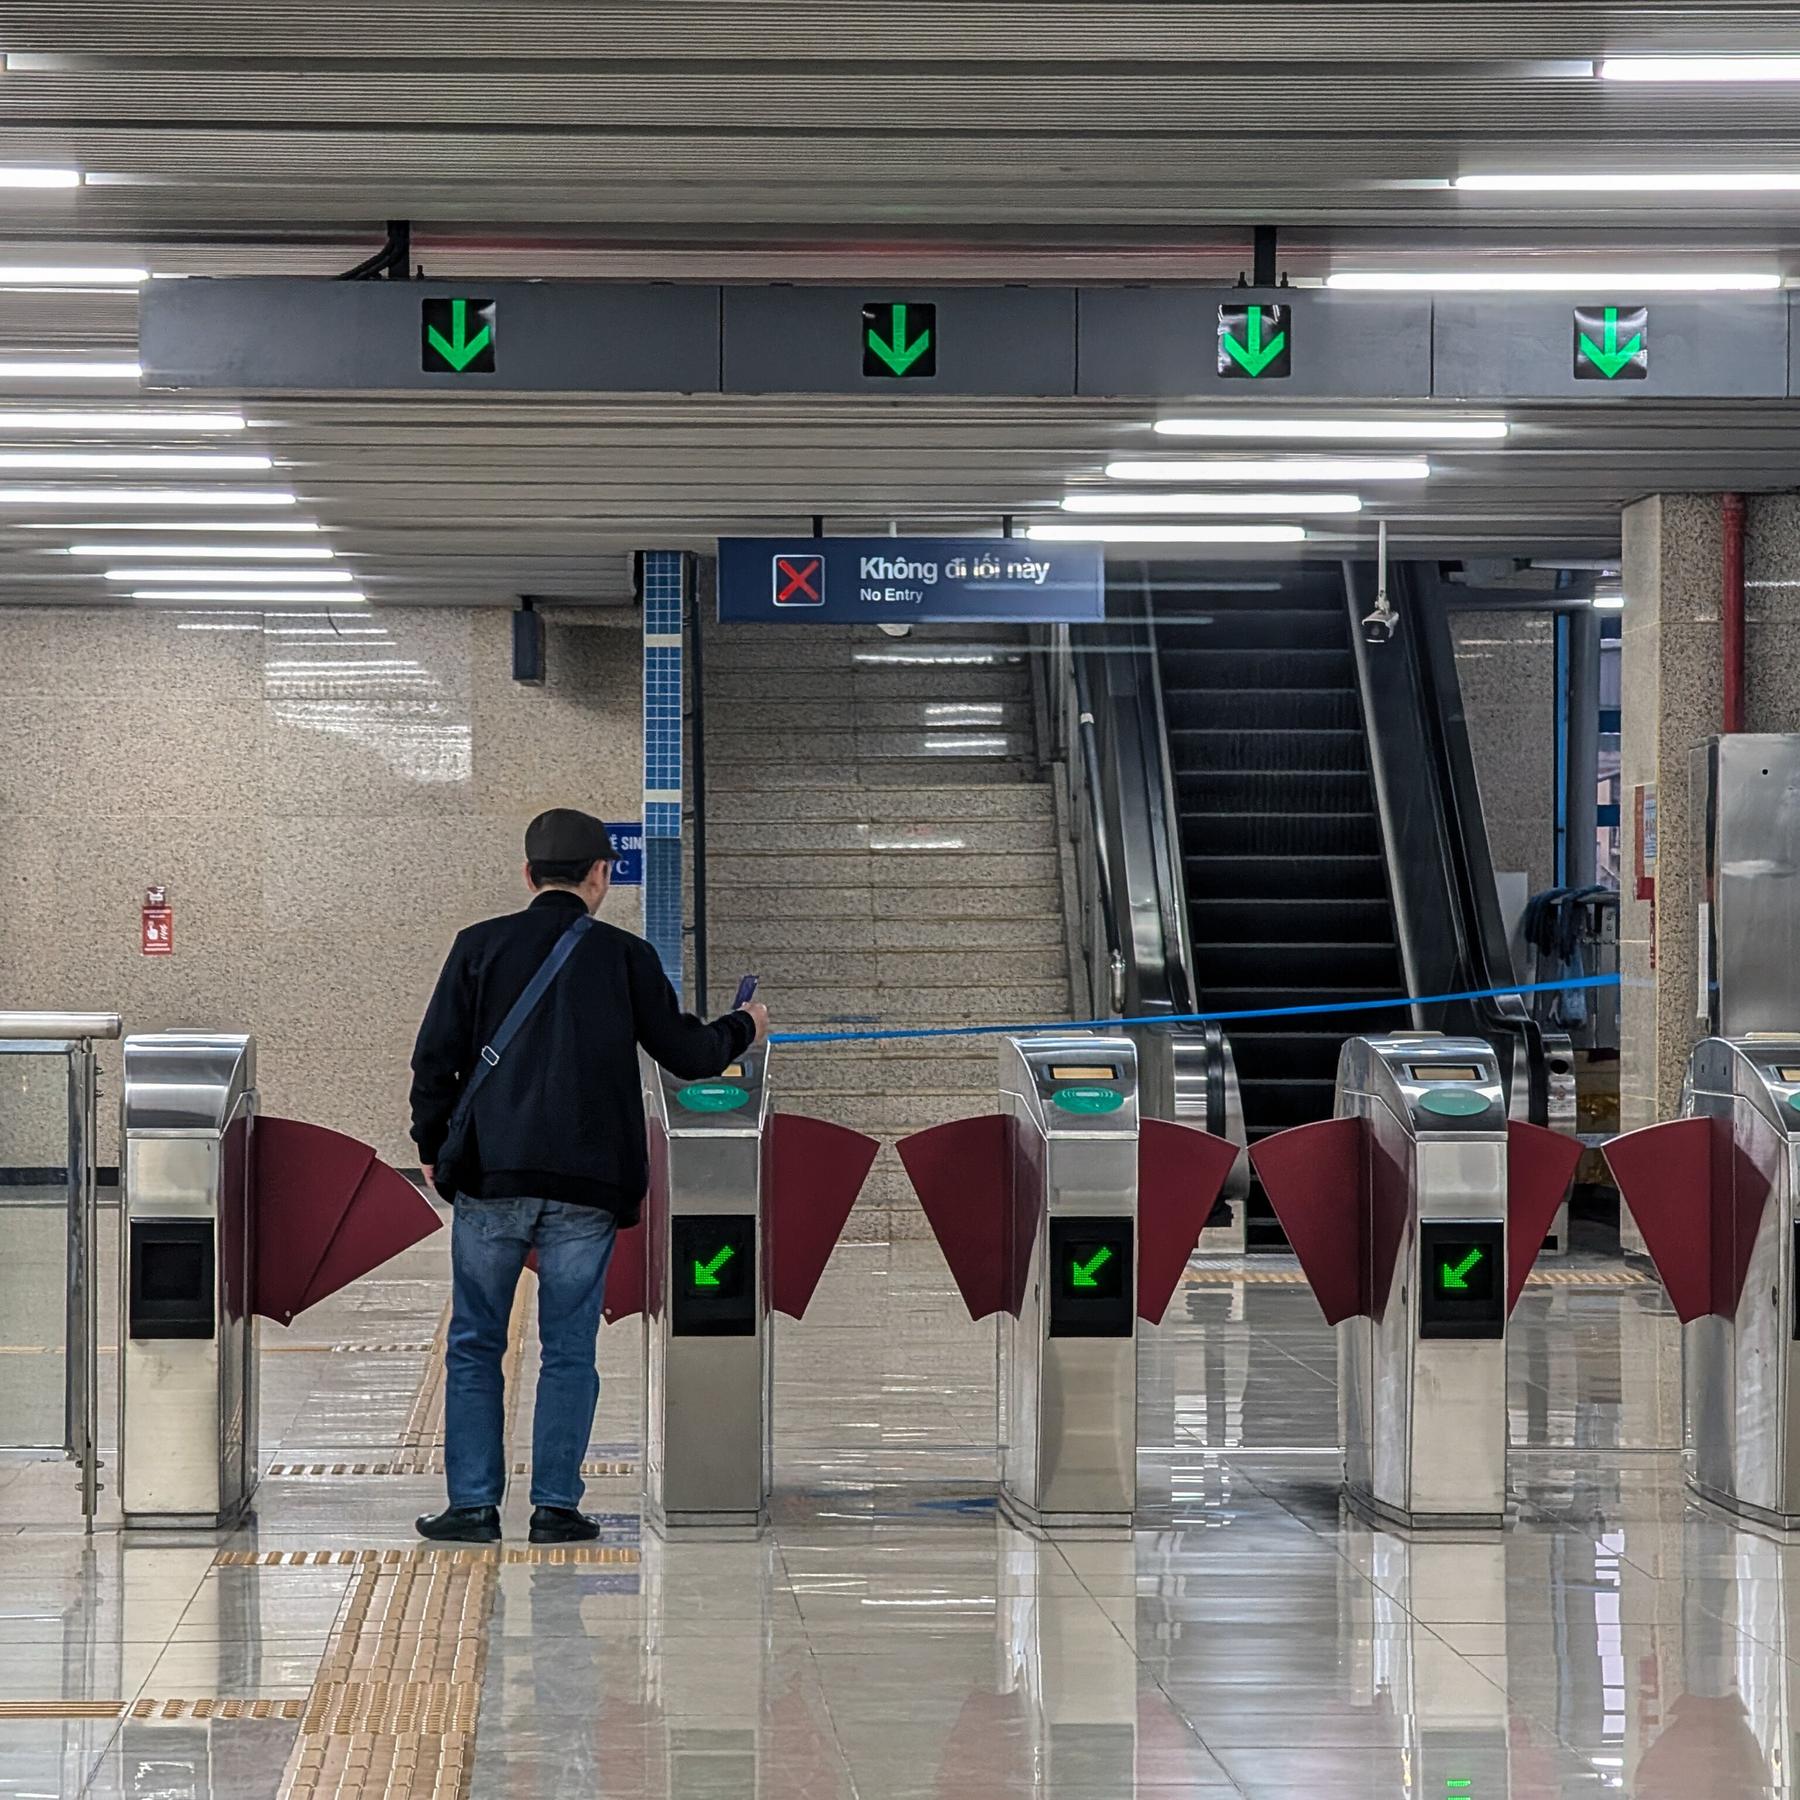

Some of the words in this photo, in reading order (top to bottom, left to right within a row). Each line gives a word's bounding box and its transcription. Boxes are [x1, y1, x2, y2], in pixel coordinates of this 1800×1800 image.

[860, 556, 938, 585] Không
[945, 557, 967, 579] đi
[973, 552, 1000, 579] lối
[1007, 557, 1050, 585] này
[860, 588, 882, 602] No
[885, 588, 923, 604] Entry
